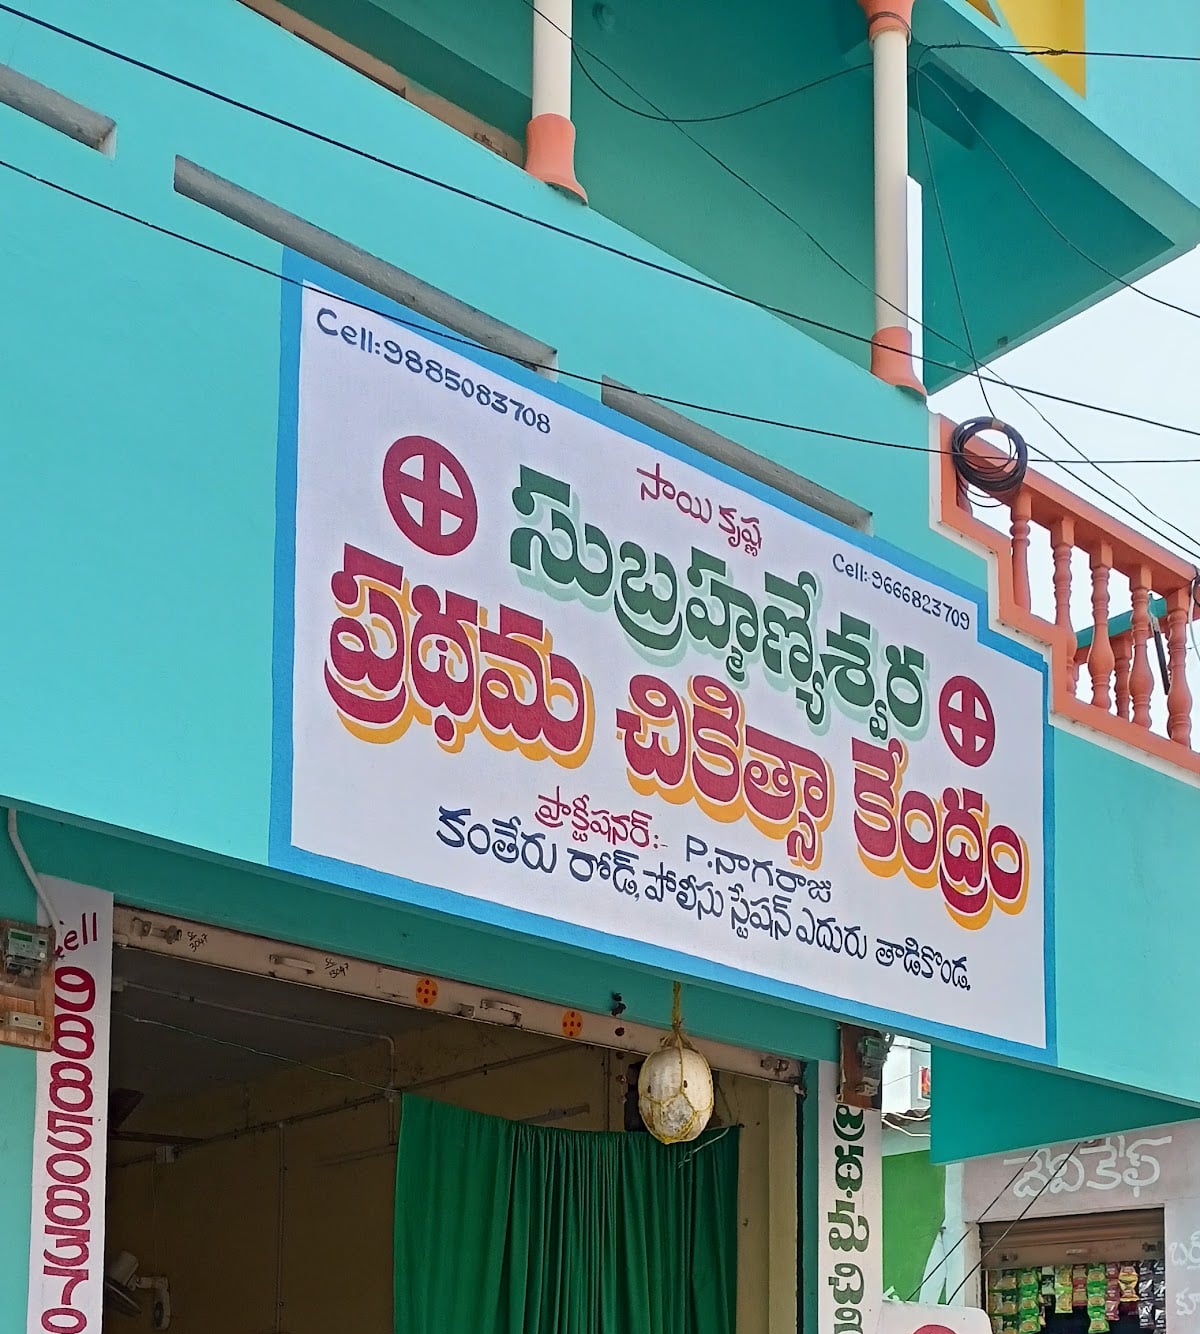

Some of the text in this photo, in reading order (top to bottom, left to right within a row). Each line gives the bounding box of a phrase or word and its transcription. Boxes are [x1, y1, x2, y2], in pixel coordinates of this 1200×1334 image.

[316, 308, 552, 434] Cell:9885083708
[636, 462, 763, 557] సాయి కృష్ణ
[324, 543, 1027, 926] ప్రథమ చికిత్సా కేంద్రం
[436, 805, 558, 875] కంతేరు
[643, 861, 724, 921] పోలీసు
[728, 882, 793, 940] స్టేషన్
[795, 907, 867, 960] ఎదురు
